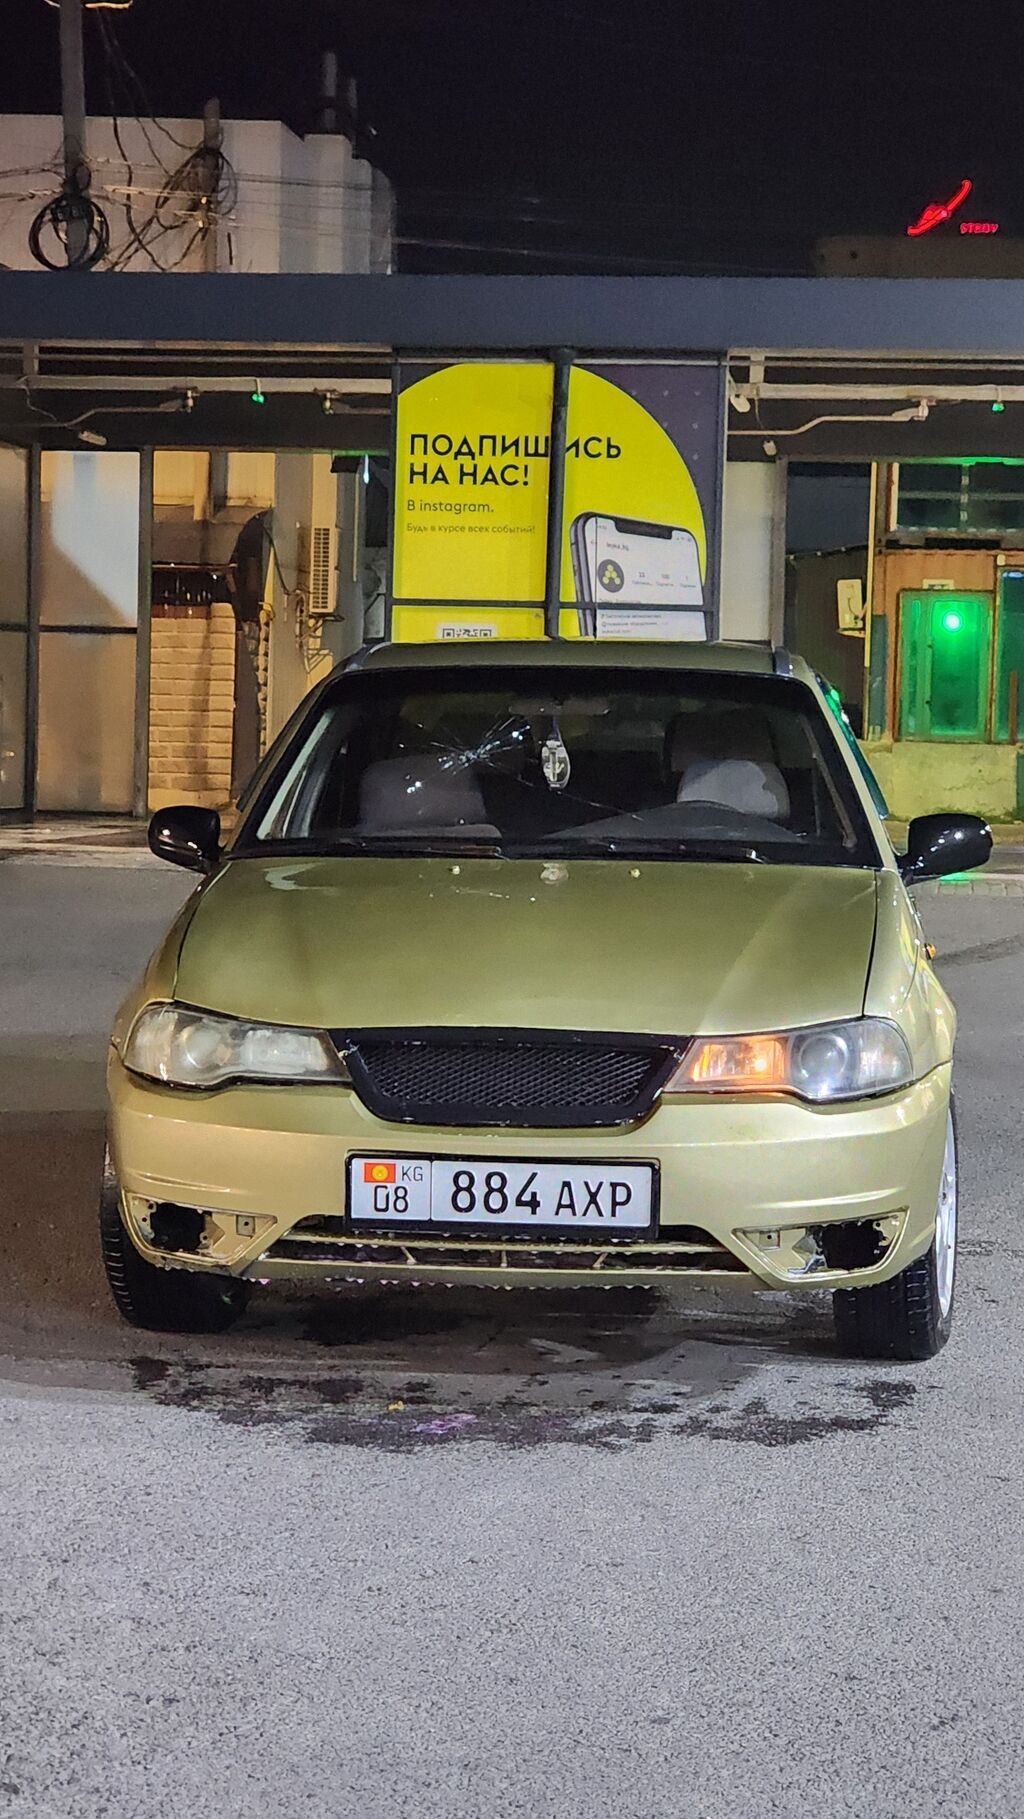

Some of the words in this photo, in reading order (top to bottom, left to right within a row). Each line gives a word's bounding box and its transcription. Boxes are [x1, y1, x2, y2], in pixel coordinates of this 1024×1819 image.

[409, 434, 622, 460] ПОДПИШИСЬ
[408, 463, 449, 485] НА
[458, 464, 530, 487] НАС!
[419, 500, 495, 515] instagram.
[407, 523, 428, 533] Будь
[438, 525, 466, 534] курсе
[468, 525, 489, 533] всех
[491, 523, 536, 534] событий!
[401, 1165, 424, 1182] KG
[373, 1185, 409, 1213] 08
[451, 1170, 541, 1216] 884
